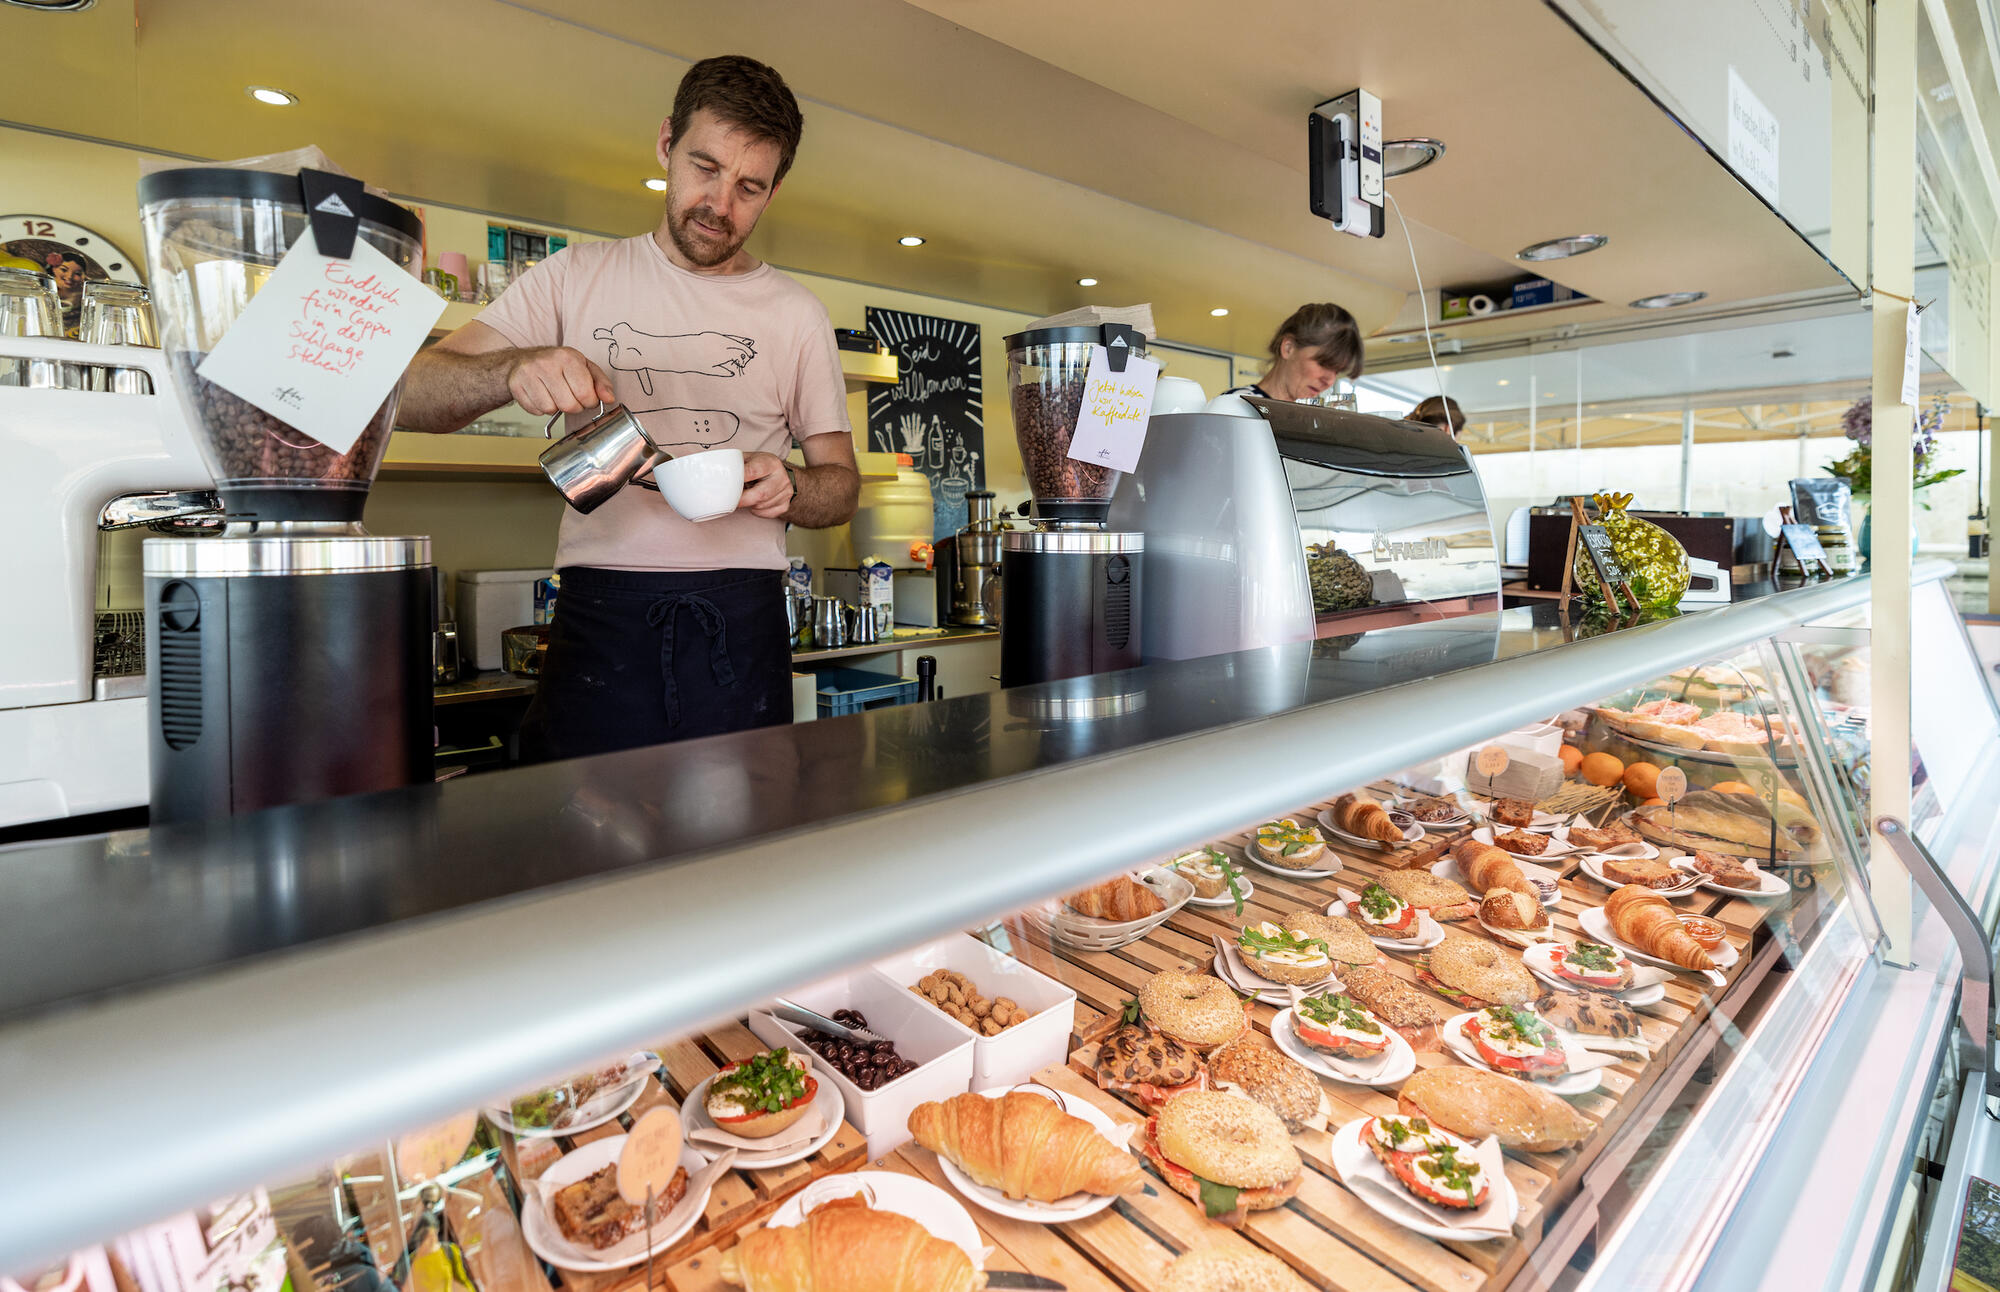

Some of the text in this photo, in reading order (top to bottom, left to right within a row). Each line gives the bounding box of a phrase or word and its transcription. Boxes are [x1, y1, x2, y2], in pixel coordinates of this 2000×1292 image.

[23, 220, 56, 238] 12
[325, 261, 400, 306] Endlich
[328, 288, 384, 314] wieder
[898, 341, 940, 374] Seid
